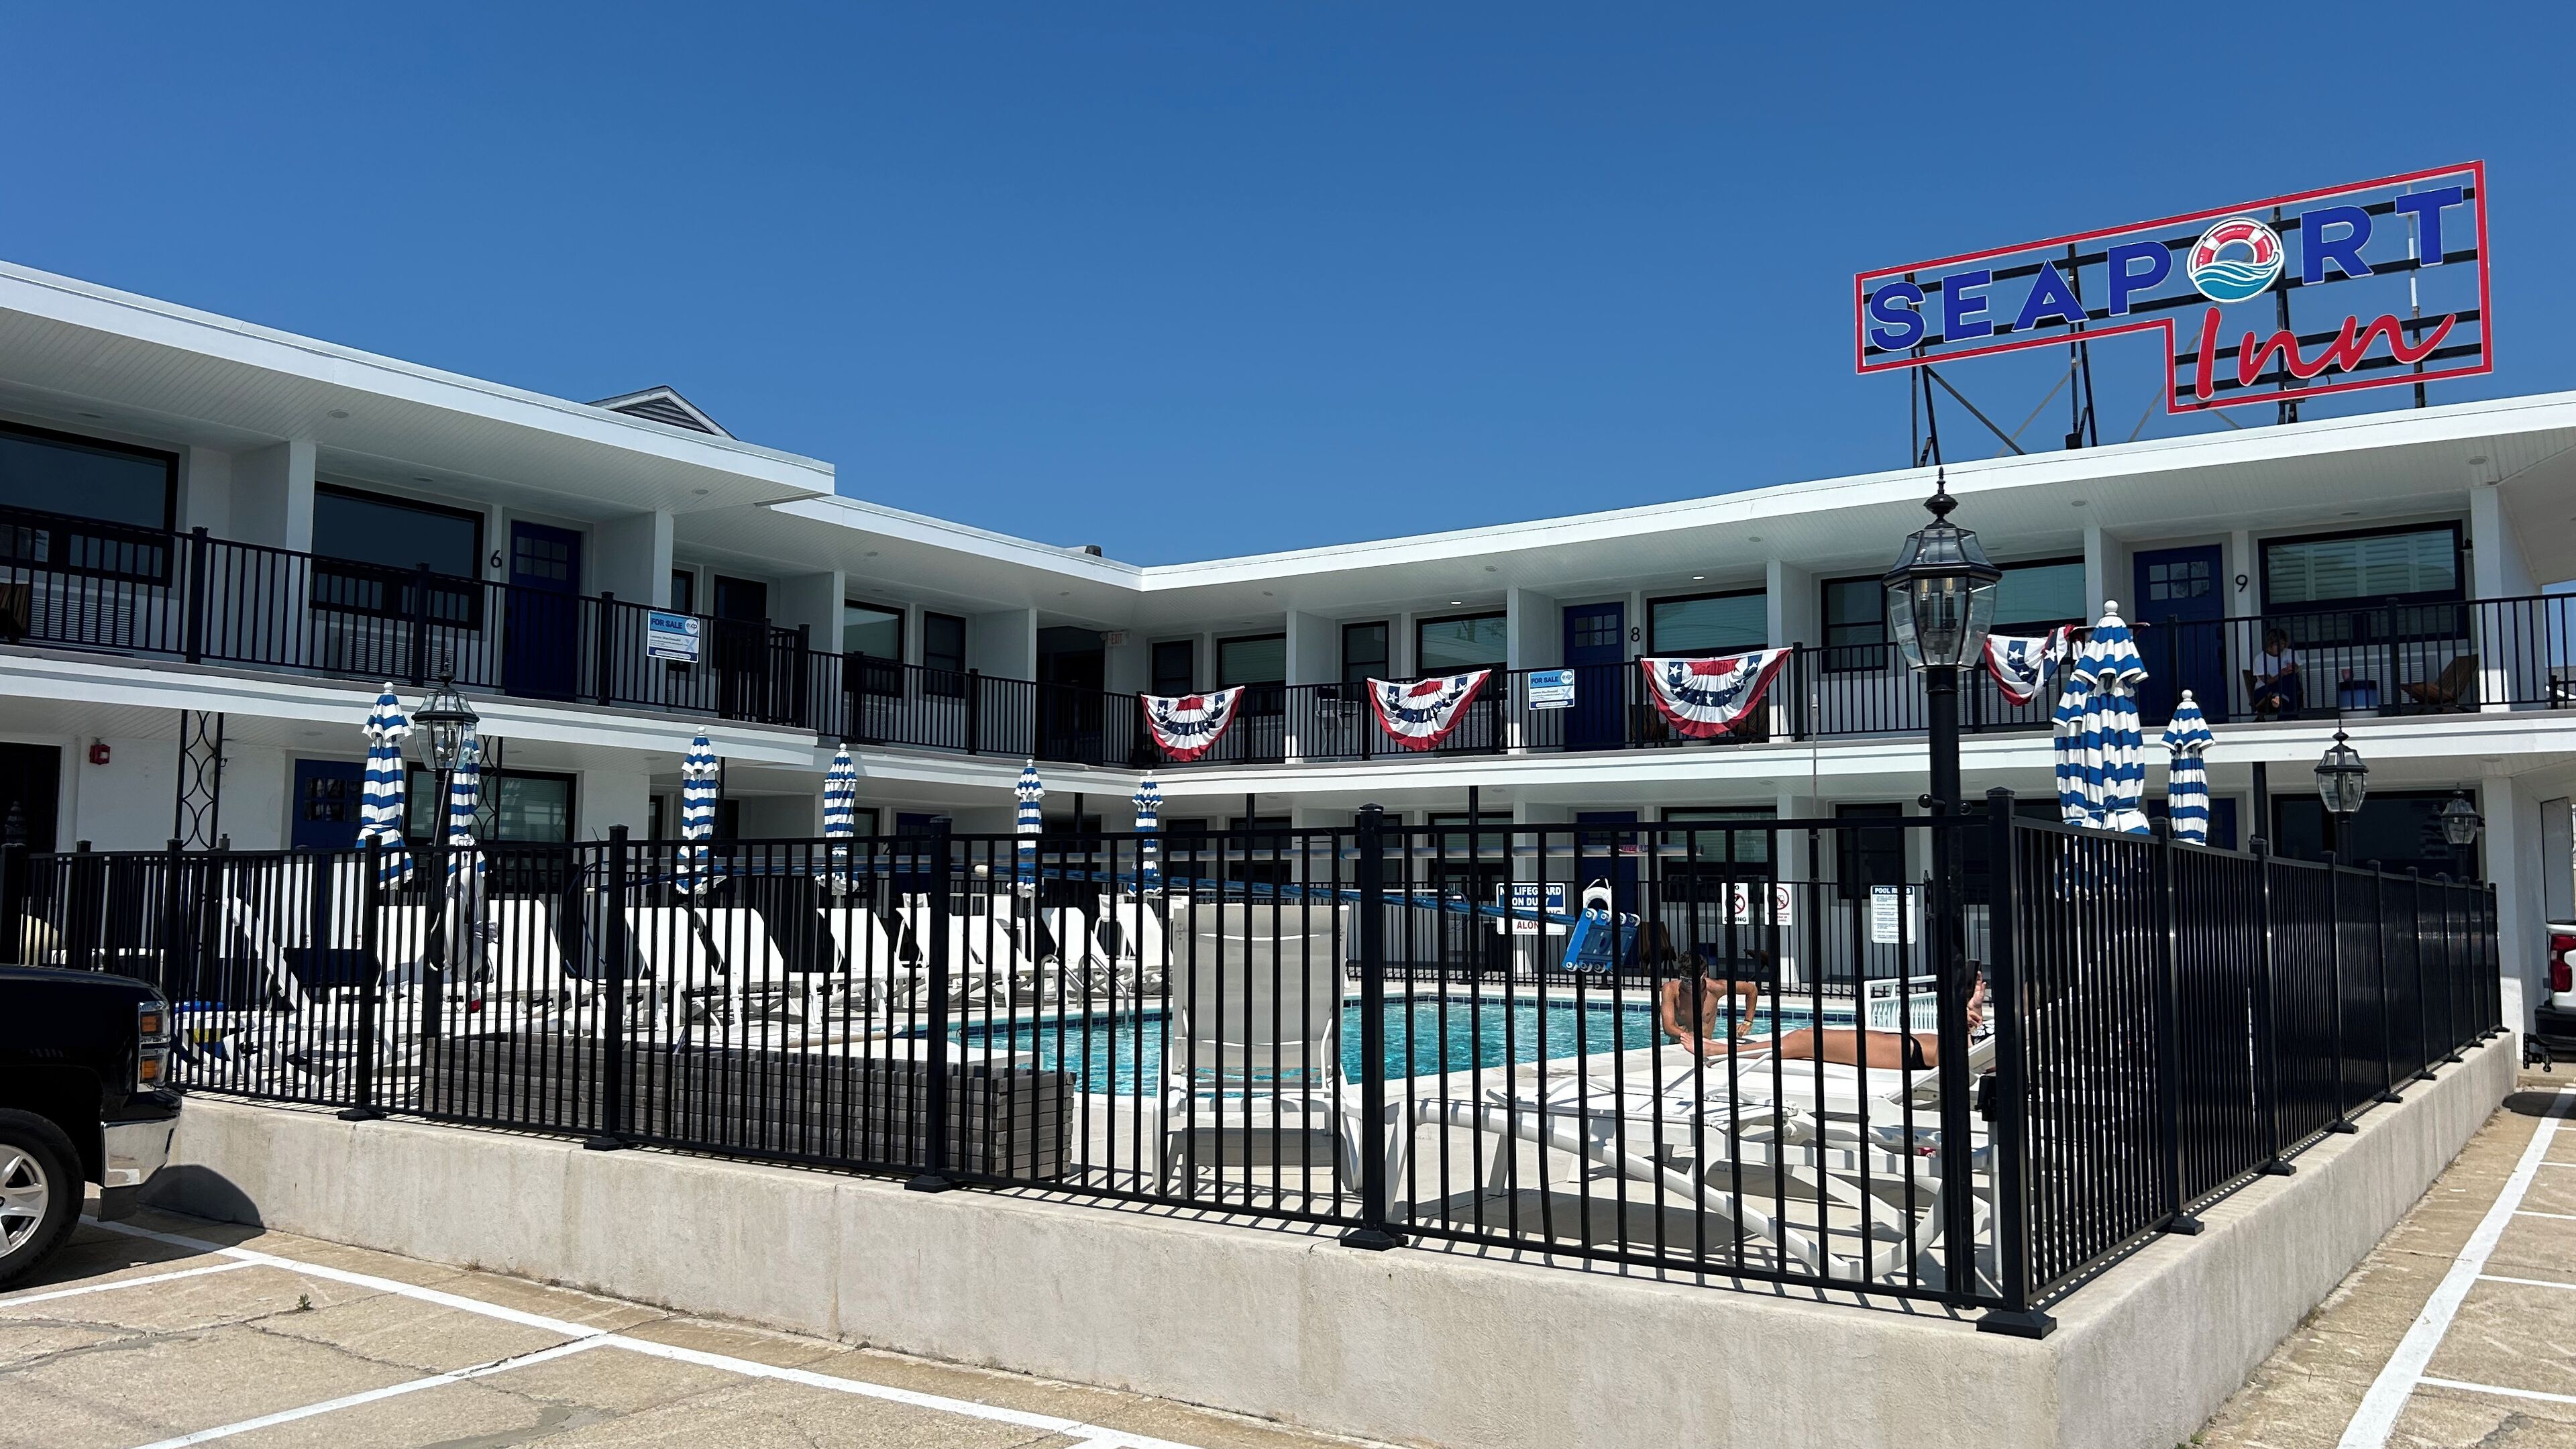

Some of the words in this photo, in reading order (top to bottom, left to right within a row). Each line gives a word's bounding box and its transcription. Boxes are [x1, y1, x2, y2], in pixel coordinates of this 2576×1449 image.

[1868, 184, 2464, 352] SEAPORT
[2194, 306, 2457, 400] Inn
[490, 549, 502, 568] 6
[2235, 574, 2248, 592] 9
[651, 618, 664, 627] FOR
[665, 620, 683, 629] SALE
[1630, 627, 1640, 642] 8
[1514, 886, 1562, 896] LIFEGARD
[1512, 897, 1524, 906] ON
[1526, 897, 1550, 906] DUY
[1516, 921, 1542, 930] ALON
